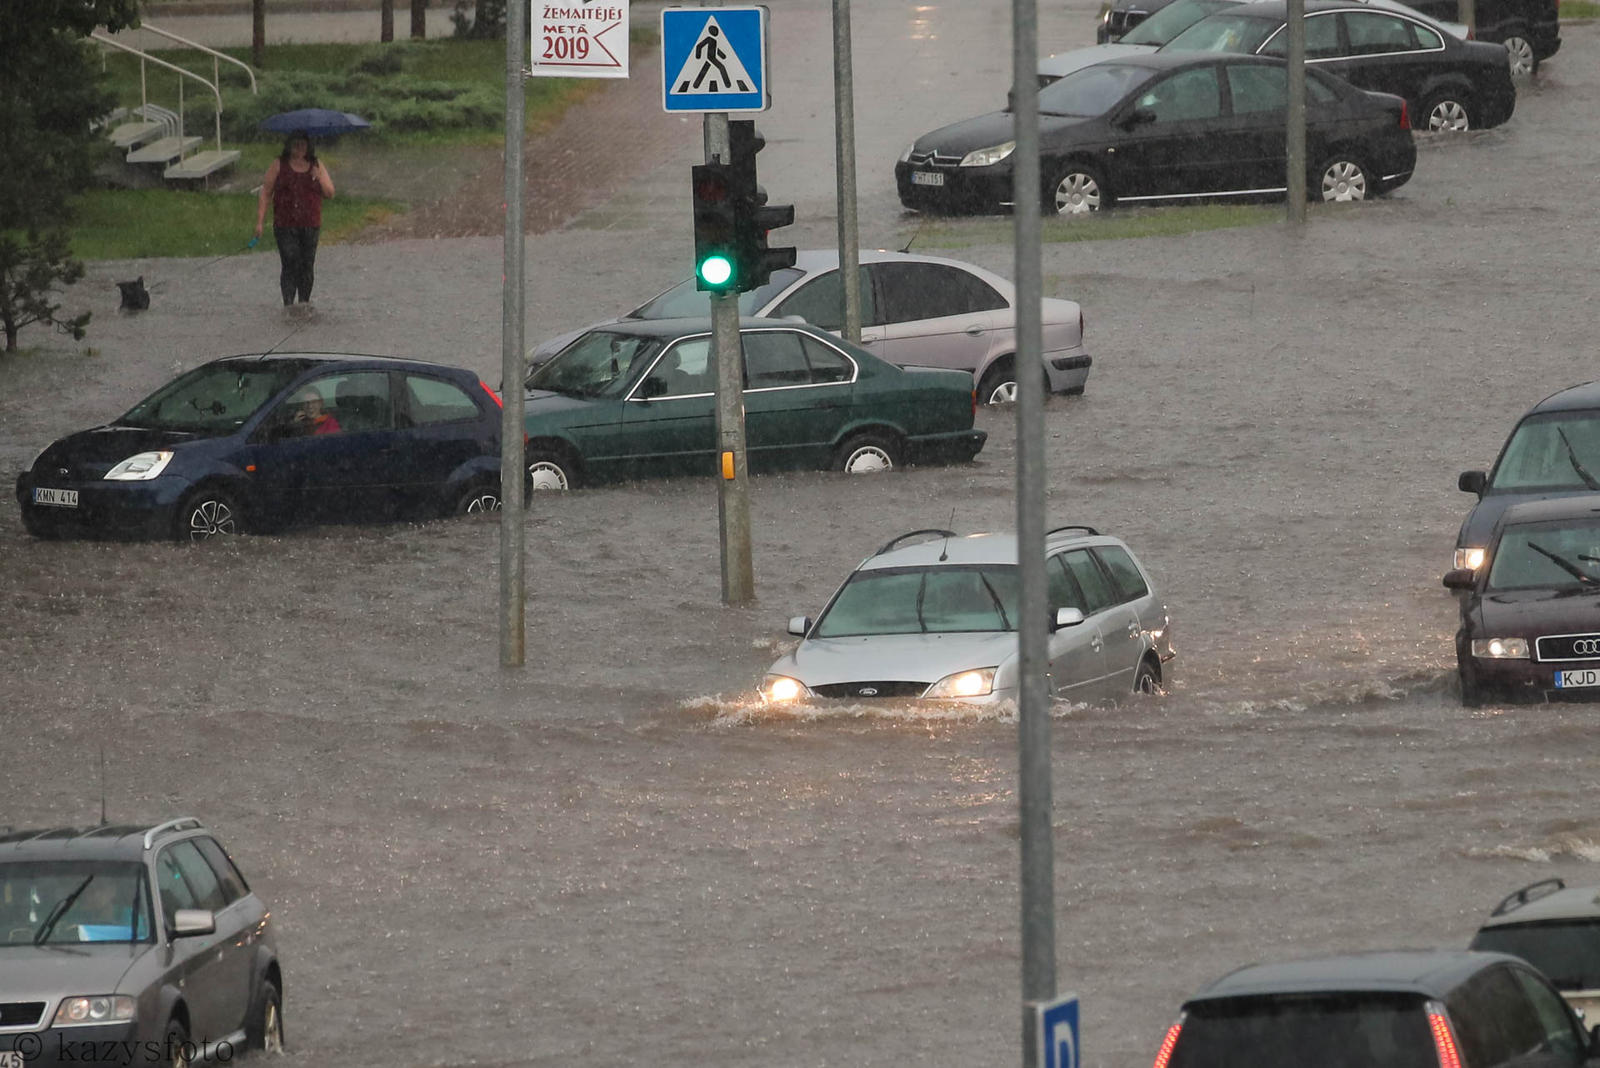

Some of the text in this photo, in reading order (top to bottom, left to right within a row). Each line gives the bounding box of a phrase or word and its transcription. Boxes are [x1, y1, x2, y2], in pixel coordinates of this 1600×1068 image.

[543, 36, 589, 59] 2019
[37, 489, 77, 504] KMN 414
[1563, 671, 1597, 686] KJD
